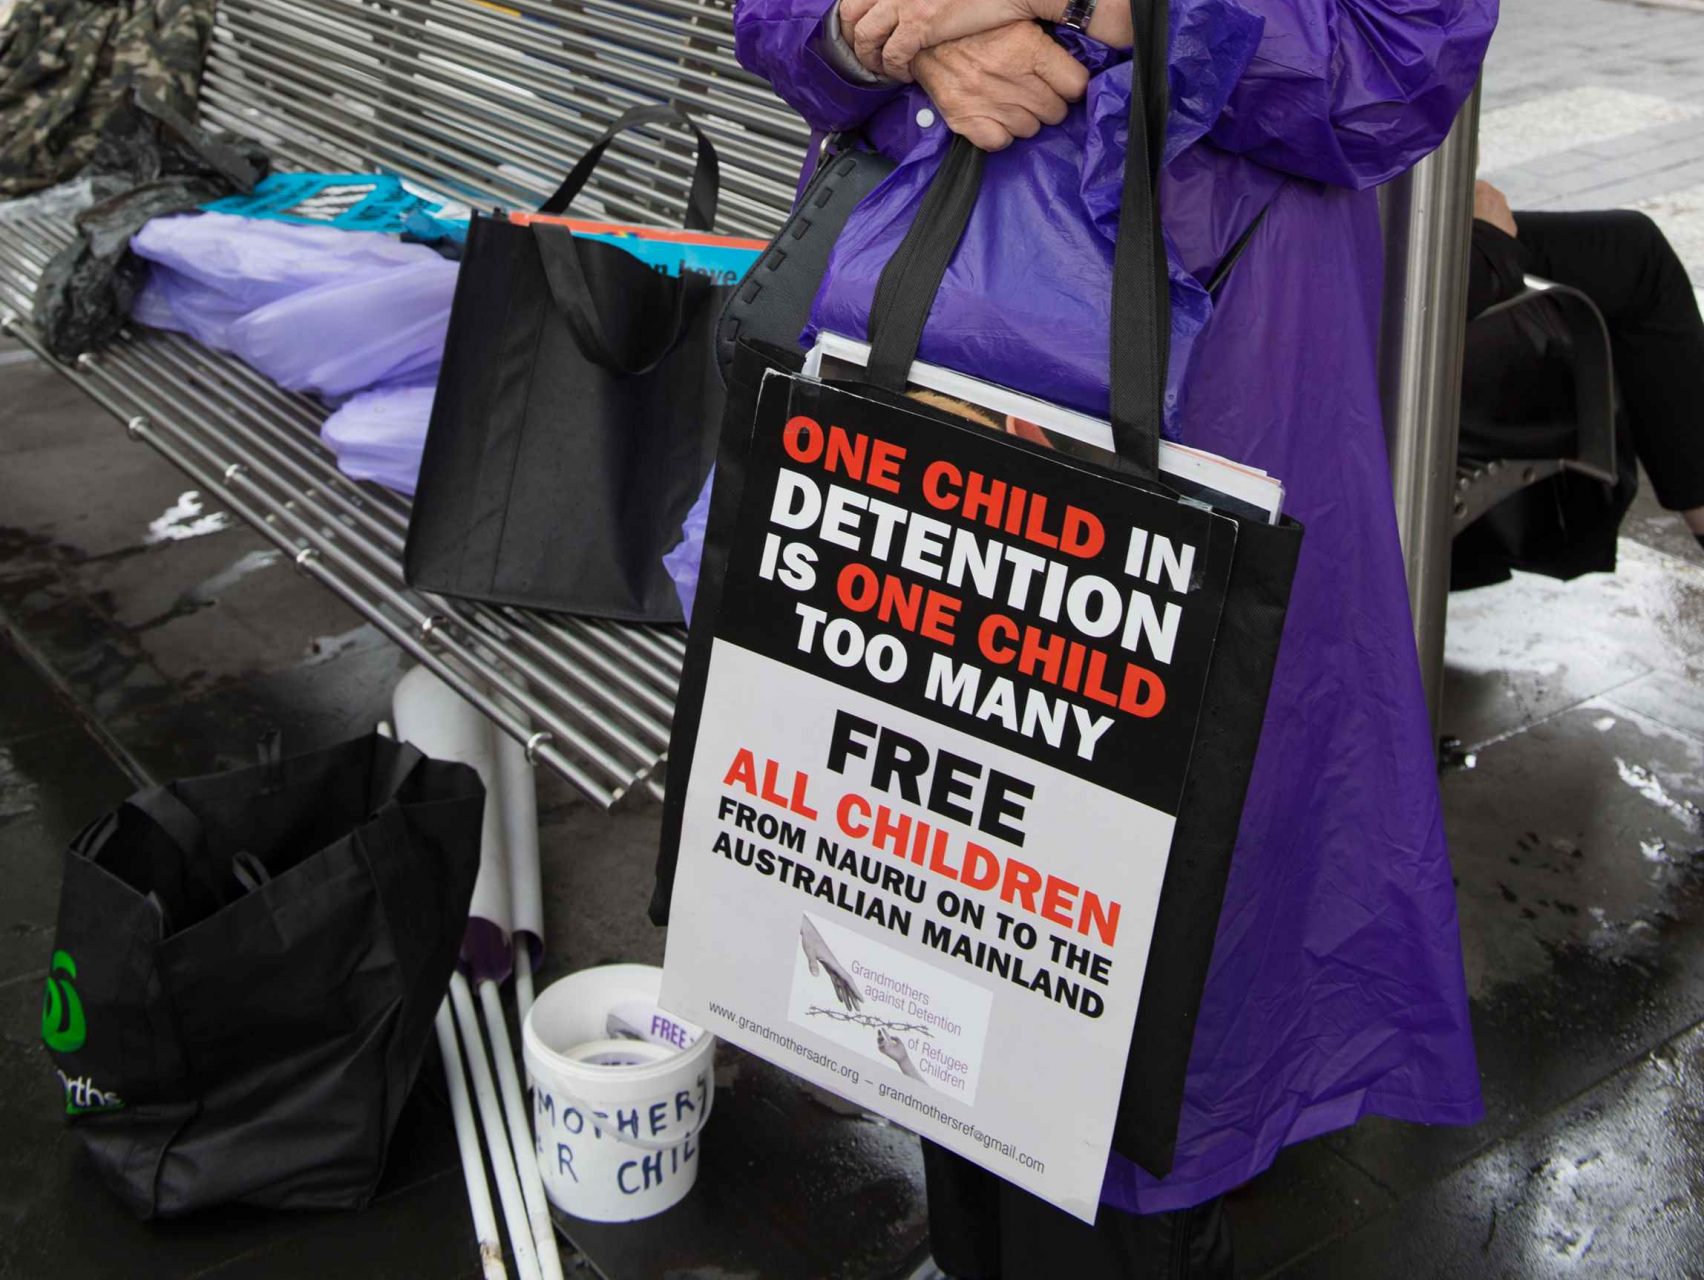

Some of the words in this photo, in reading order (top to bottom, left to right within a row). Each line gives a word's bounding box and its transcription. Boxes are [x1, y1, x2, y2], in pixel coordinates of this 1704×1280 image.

[769, 466, 1183, 665] DETENTION
[782, 415, 907, 494] ONE
[922, 460, 1105, 560] CHILD
[1125, 526, 1197, 595] IN
[758, 532, 820, 592] IS
[837, 563, 963, 645] ONE
[978, 613, 1166, 718] CHILD
[795, 602, 908, 684] TOO
[924, 655, 1115, 762] MANY
[723, 747, 818, 821] ALL
[836, 793, 1122, 947] CHILDREN
[826, 709, 1036, 848] FREE
[712, 831, 912, 936] AUSTRALIAN
[922, 919, 1105, 1019] MAINLAND
[718, 795, 806, 854] FROM
[816, 836, 926, 904] NAURU
[937, 890, 985, 931] ON
[996, 912, 1038, 951] TO
[1049, 935, 1112, 986] THE
[651, 1015, 687, 1049] FREE
[850, 960, 930, 1006] Grandmothers
[864, 983, 905, 1012] against
[908, 1002, 962, 1036] Detention
[907, 1037, 919, 1051] of
[922, 1041, 969, 1075] Refugee
[708, 1001, 859, 1084] www.grandmothersadrc.org
[879, 1081, 1046, 1175] grandmothersref@gmail.com
[919, 1059, 966, 1091] Children
